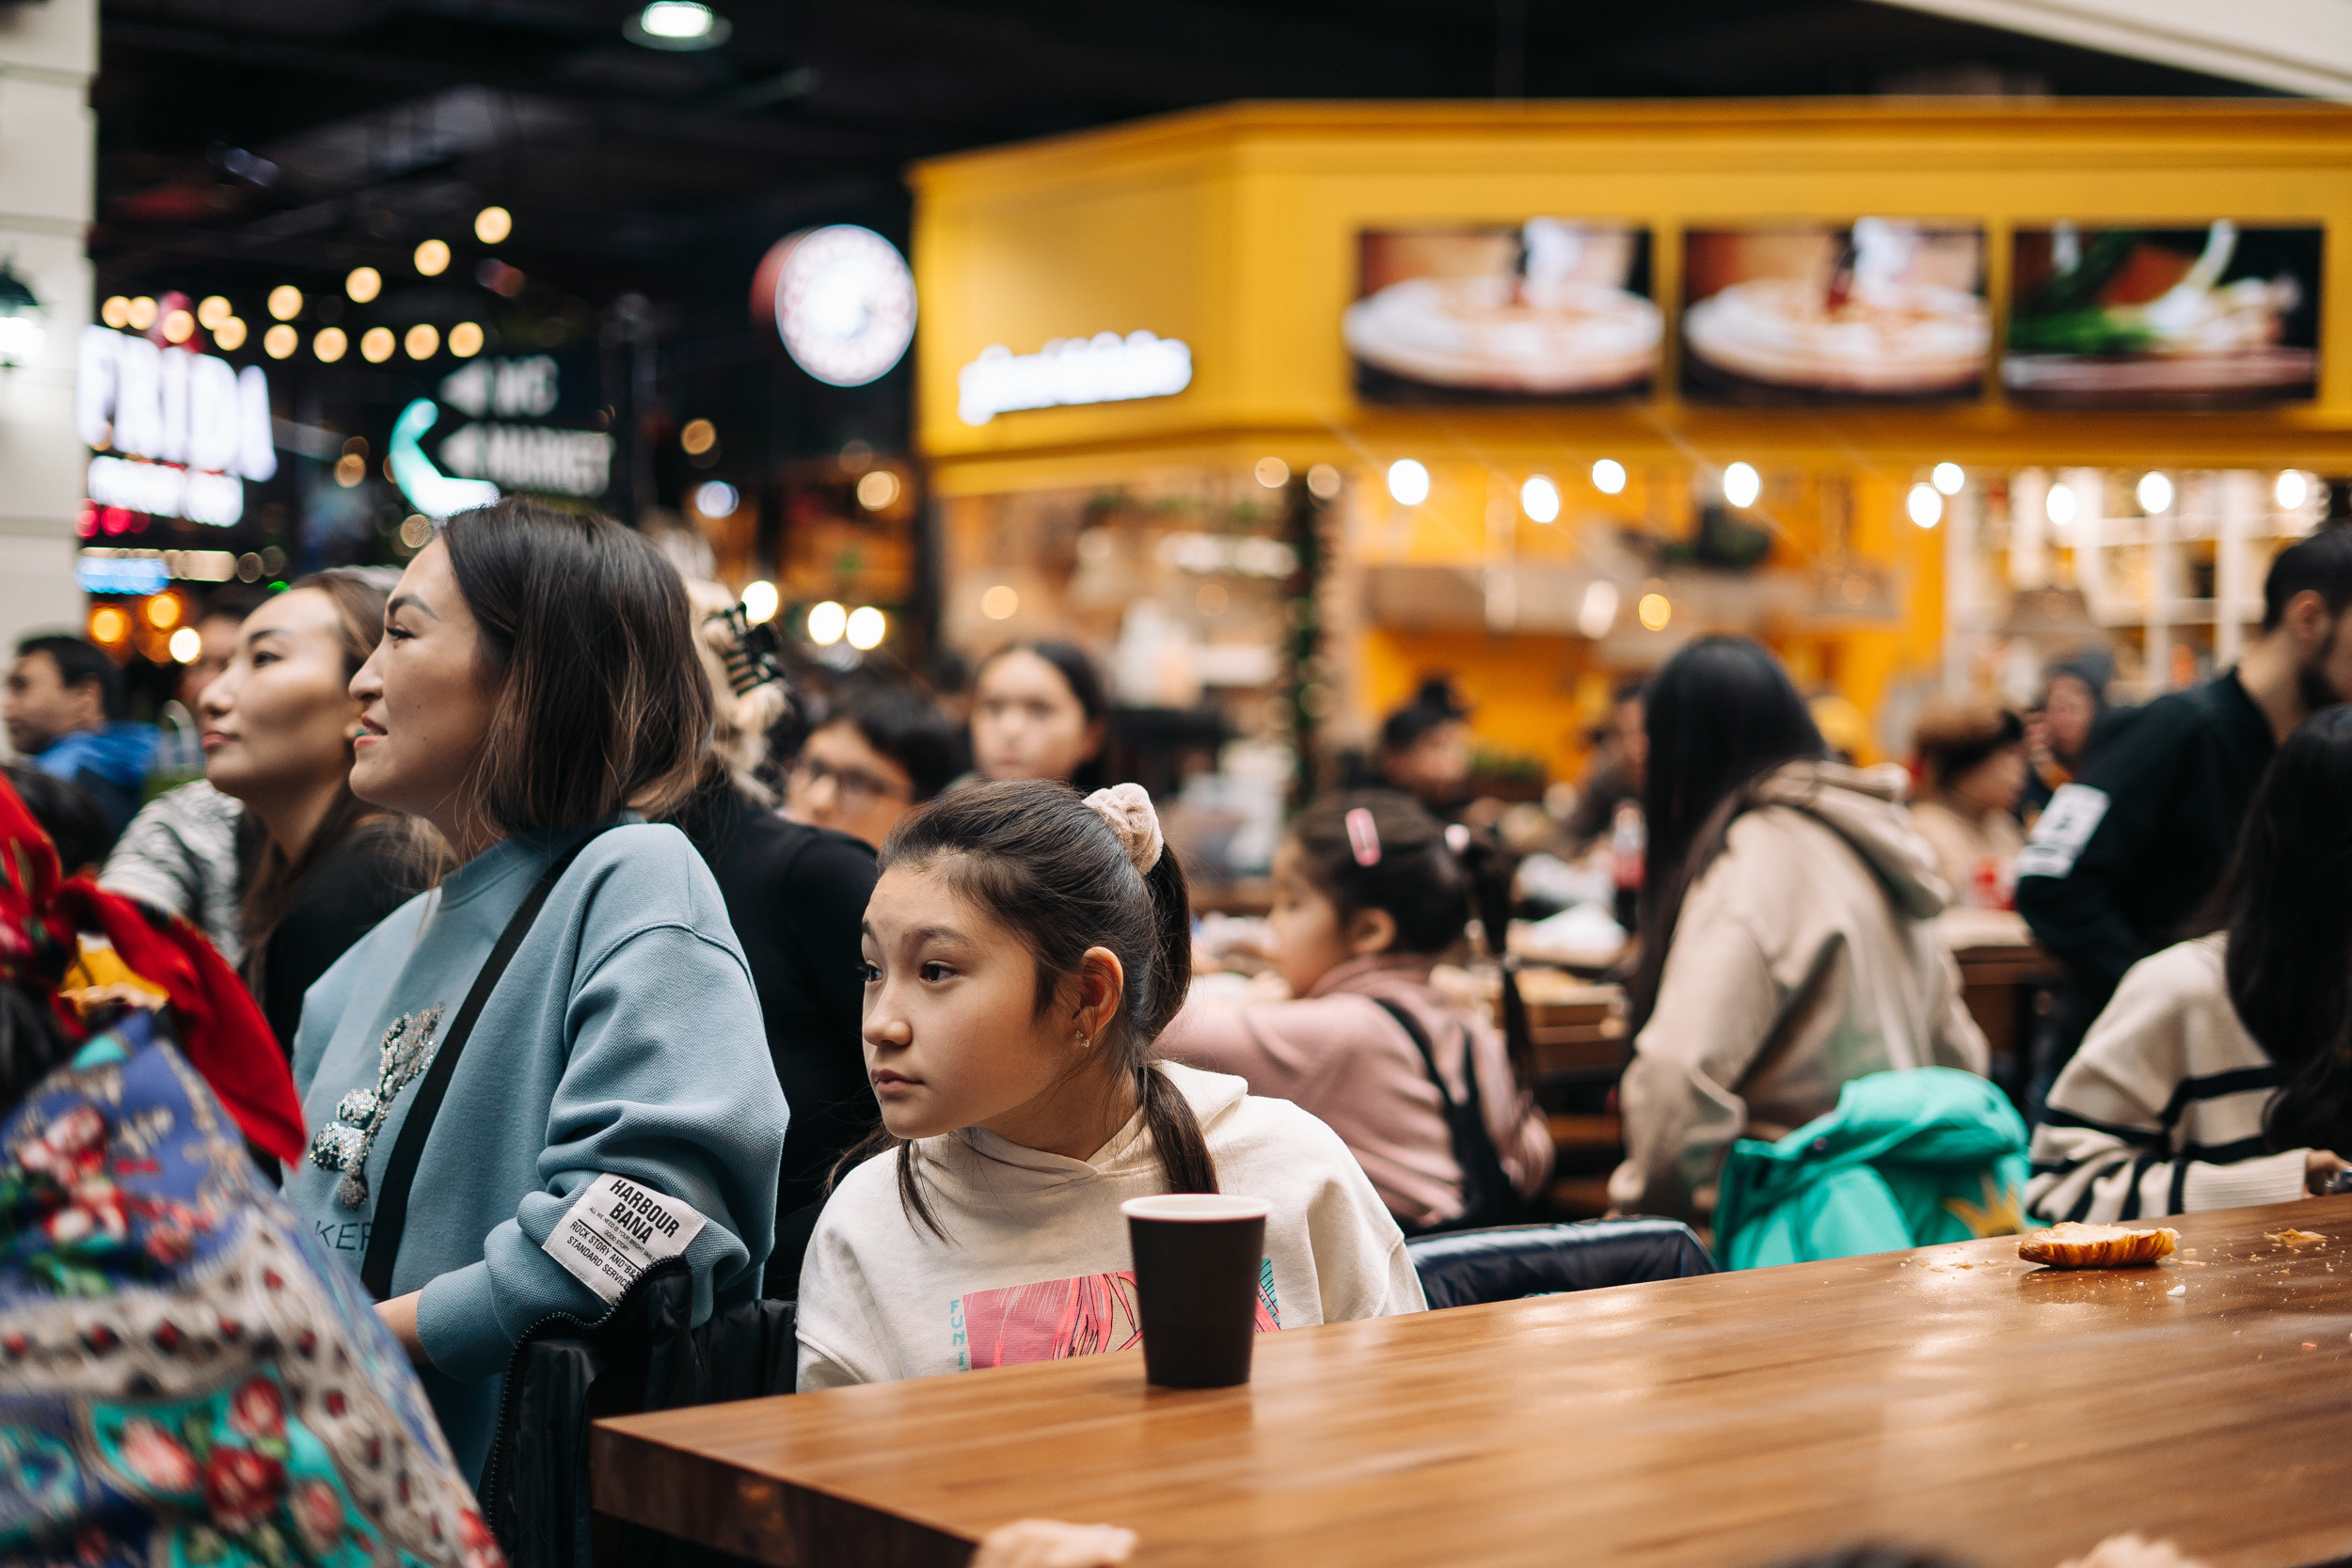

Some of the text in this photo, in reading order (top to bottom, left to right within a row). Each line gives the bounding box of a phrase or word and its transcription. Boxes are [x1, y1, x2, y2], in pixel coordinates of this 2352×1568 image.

[609, 1179, 680, 1239] HARBOUR
[609, 1201, 654, 1244] BANA
[569, 1221, 591, 1240] ROCK
[588, 1235, 611, 1257] STORY
[589, 1206, 597, 1215] ALL
[596, 1212, 605, 1220] WE
[603, 1217, 615, 1228] NEED
[619, 1228, 631, 1242] YOUR
[629, 1238, 645, 1253] BRIGHT
[603, 1228, 630, 1252] GOOD STORY
[566, 1235, 604, 1267] STANDARD
